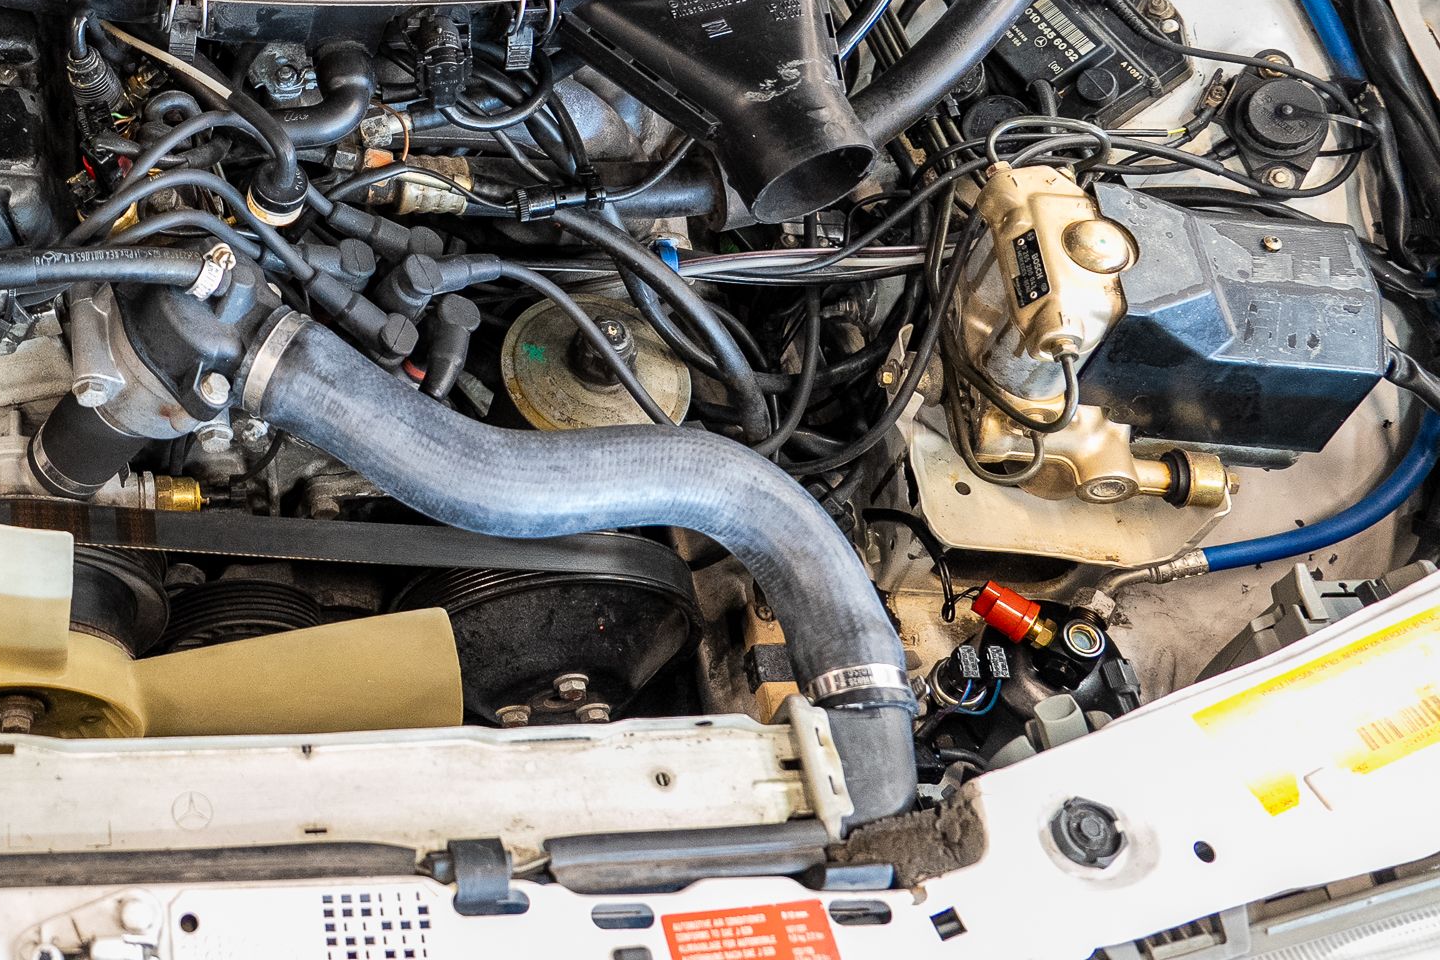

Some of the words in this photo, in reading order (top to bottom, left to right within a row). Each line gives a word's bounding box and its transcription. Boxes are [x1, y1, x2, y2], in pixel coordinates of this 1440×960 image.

[1025, 7, 1041, 24] 010
[1037, 22, 1056, 40] 545
[1053, 38, 1067, 51] 60
[1065, 48, 1079, 62] 32
[1031, 252, 1044, 280] BOSCH
